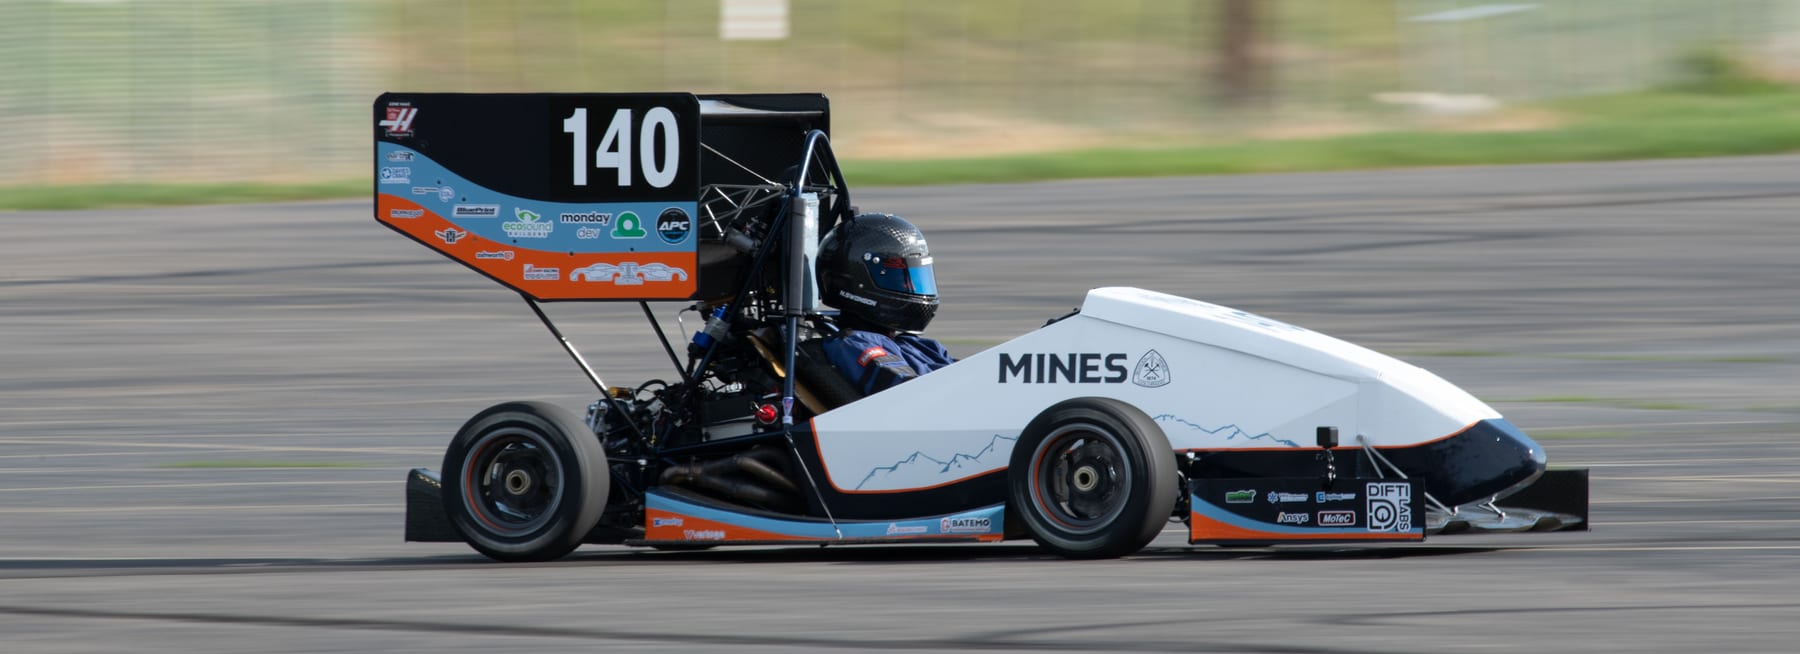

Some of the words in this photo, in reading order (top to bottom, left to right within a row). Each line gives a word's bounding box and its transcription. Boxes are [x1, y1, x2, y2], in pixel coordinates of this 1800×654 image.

[563, 106, 680, 188] 140
[561, 213, 611, 225] monday
[503, 221, 552, 232] ecosound
[658, 221, 689, 231] APC
[577, 227, 600, 238] dev
[998, 353, 1128, 384] MINES
[1368, 485, 1408, 496] DIFTI
[1277, 512, 1309, 524] Ansys
[1323, 514, 1351, 523] MoTeC
[1399, 498, 1409, 530] LABS
[952, 519, 990, 527] BATEMO
